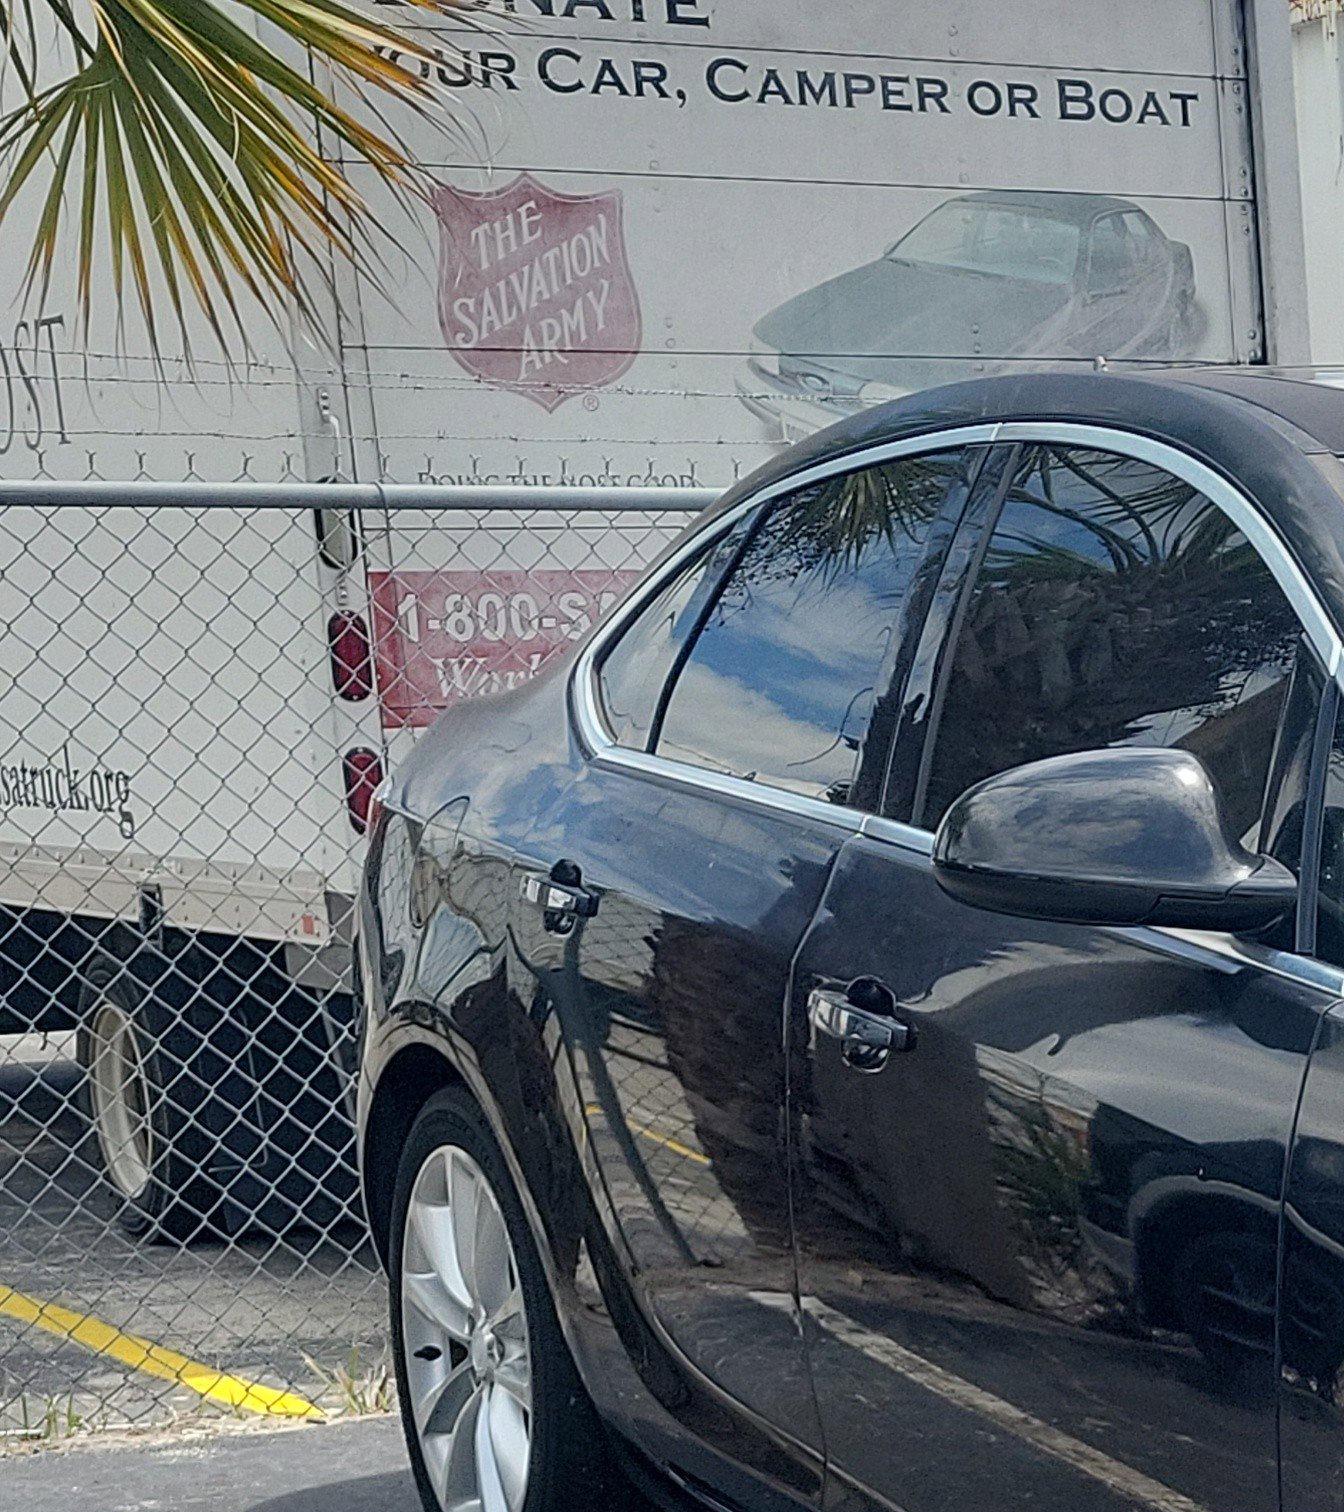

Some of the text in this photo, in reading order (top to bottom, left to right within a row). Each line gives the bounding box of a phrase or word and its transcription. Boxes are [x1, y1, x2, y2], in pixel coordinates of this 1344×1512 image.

[374, 45, 1200, 128] OUR CAR, CAMPER OR BOAT
[451, 212, 613, 349] SALVATION
[470, 199, 544, 271] THE
[516, 277, 611, 382] ARMY
